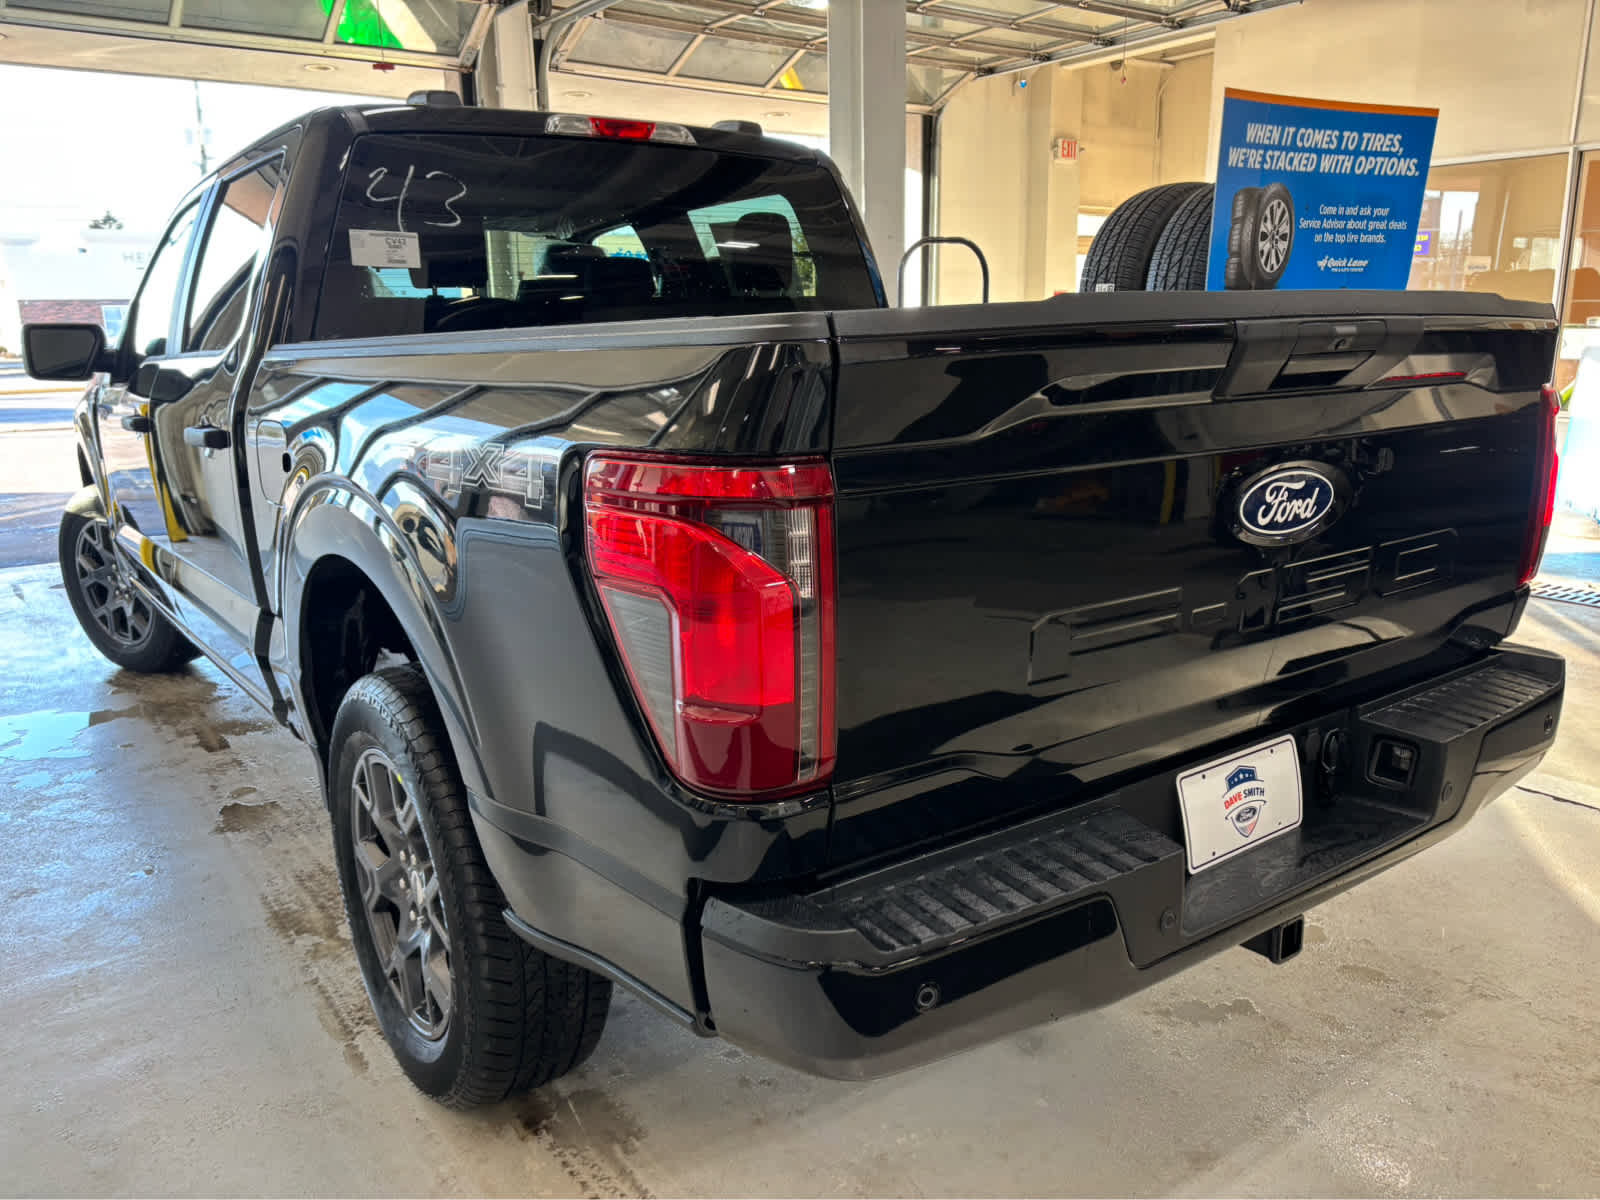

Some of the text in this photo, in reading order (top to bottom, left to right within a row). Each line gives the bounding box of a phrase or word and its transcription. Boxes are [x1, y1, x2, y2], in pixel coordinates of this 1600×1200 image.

[1062, 139, 1078, 160] EXIT
[1246, 122, 1404, 156] WHEN IT COMES TO TIRES,
[1228, 146, 1420, 177] WE'RE STACKED WITH OPTIONS.
[366, 164, 468, 232] 43
[1319, 204, 1390, 218] Come in and ask your
[1299, 217, 1408, 231] Service Advisor about great deals
[1314, 232, 1386, 244] on the top tire brands.
[1327, 257, 1369, 268] Quick Lane
[1256, 480, 1319, 527] Ford
[1027, 527, 1458, 687] F-150
[1224, 787, 1265, 809] DAVE SMITH
